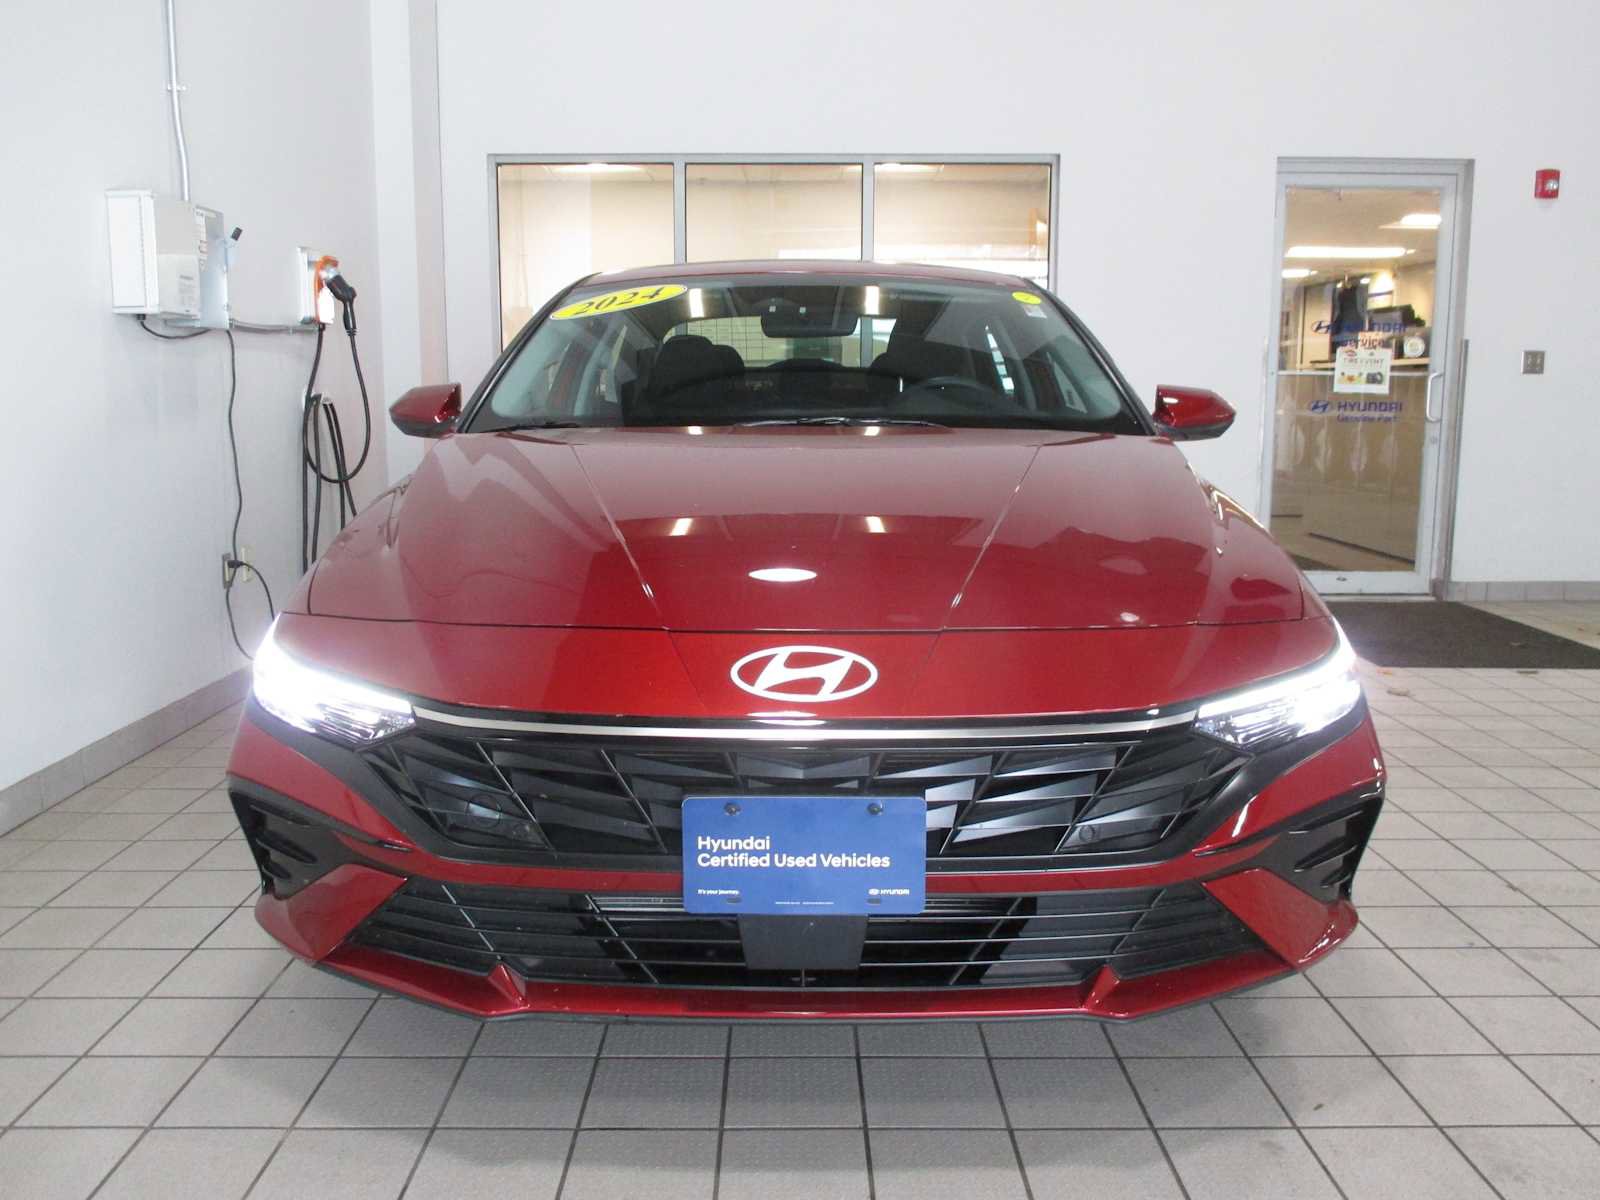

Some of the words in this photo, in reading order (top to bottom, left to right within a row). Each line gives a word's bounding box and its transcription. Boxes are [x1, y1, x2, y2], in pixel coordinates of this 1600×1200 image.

[573, 286, 665, 315] 2024
[1337, 401, 1402, 412] HYUNDAI
[697, 836, 770, 852] Hyundai
[697, 853, 770, 868] Certified
[774, 854, 817, 868] Used
[819, 853, 891, 868] Vehicles
[880, 888, 910, 896] HYUNDAI
